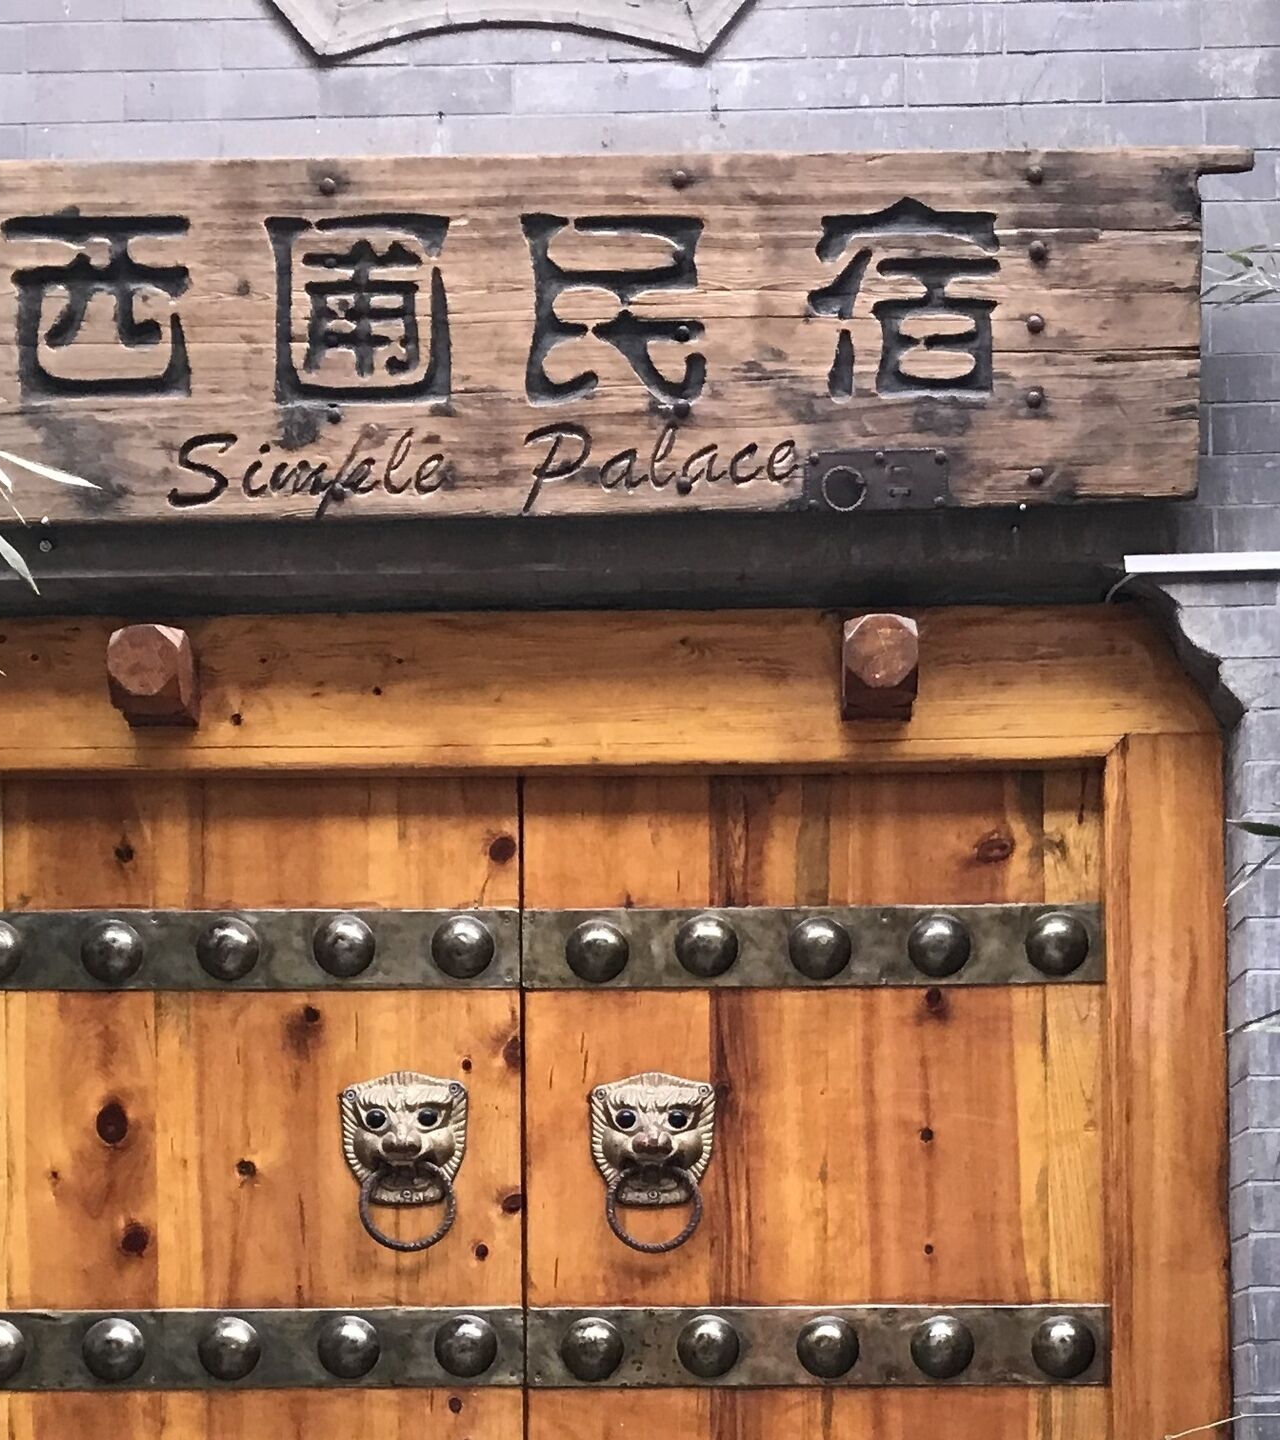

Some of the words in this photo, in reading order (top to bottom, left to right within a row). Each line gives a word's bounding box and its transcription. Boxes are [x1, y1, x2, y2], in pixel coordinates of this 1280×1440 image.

[1, 196, 1002, 404] 西圃民宿
[168, 432, 448, 517] Simple
[523, 420, 804, 514] Palace
